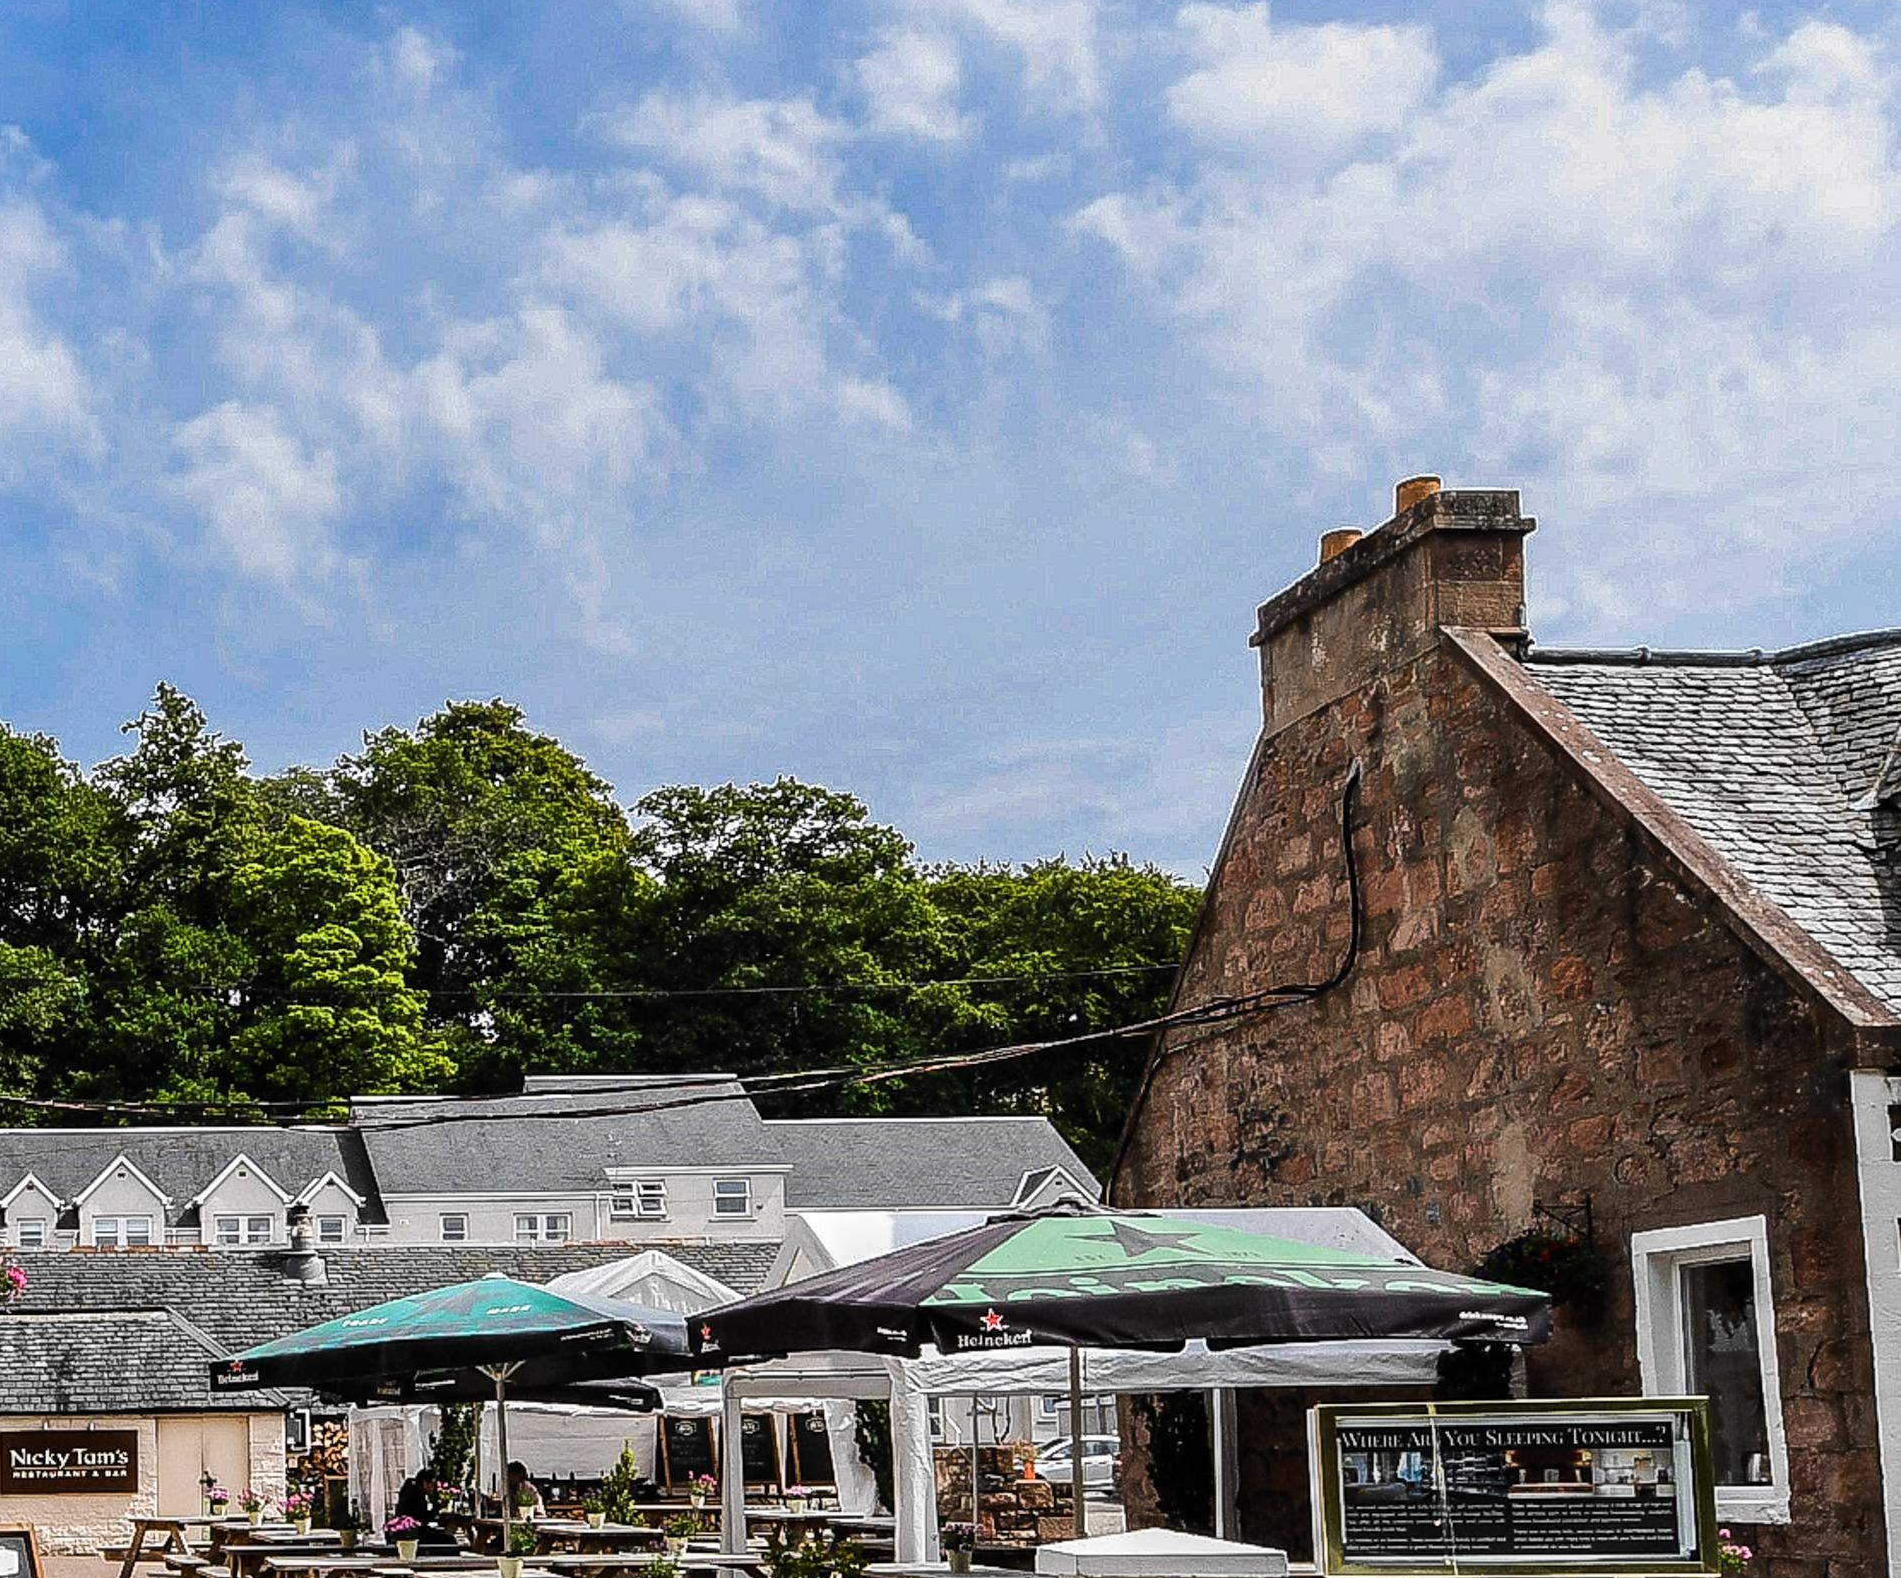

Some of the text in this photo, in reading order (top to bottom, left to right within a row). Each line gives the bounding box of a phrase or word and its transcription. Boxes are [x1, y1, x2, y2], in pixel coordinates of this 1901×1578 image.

[957, 1329, 1032, 1349] Heineken
[1342, 1432, 1402, 1448] WHERE
[1445, 1430, 1479, 1446] YOU
[1486, 1429, 1564, 1446] SLEEPING
[9, 1448, 129, 1470] Nicky Tam's
[12, 1470, 127, 1479] RESTAURANT & BAR
